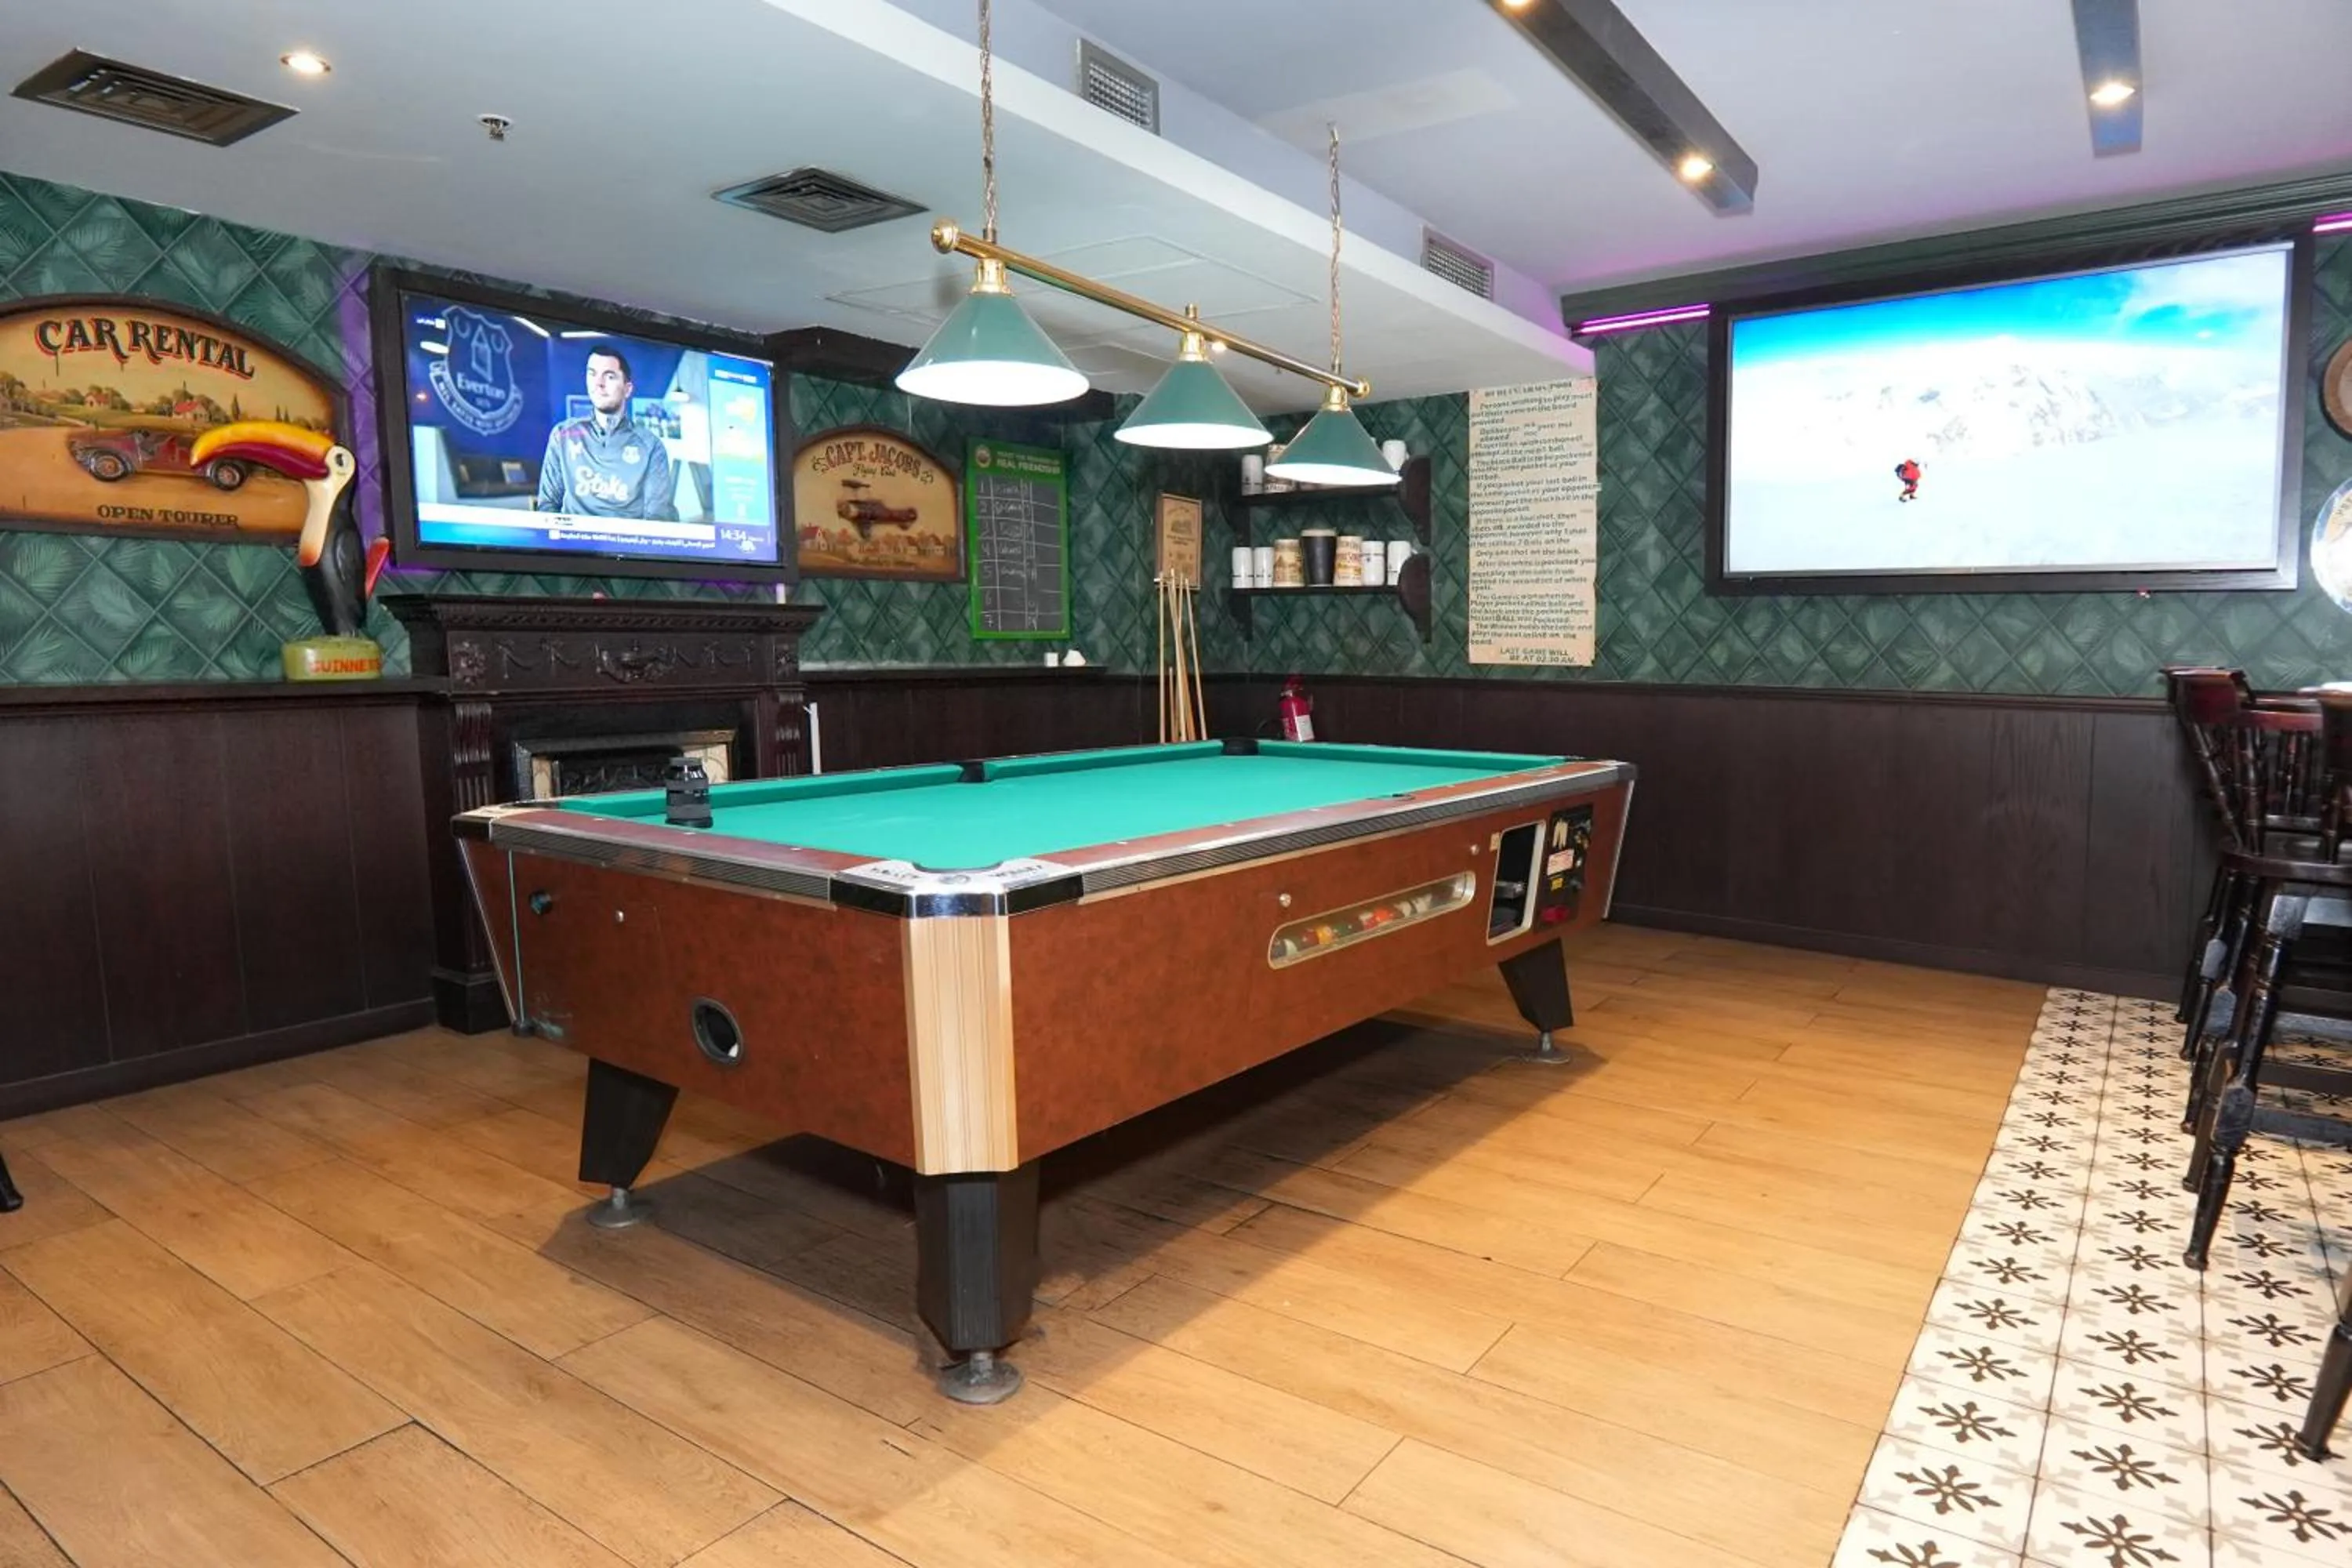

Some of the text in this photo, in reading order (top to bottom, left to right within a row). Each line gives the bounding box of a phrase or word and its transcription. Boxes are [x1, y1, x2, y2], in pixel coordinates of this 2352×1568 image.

[34, 317, 256, 381] CAR RENTAL
[456, 372, 506, 399] Everton
[869, 443, 921, 478] JACOBS
[575, 465, 629, 502] Stake
[97, 504, 239, 528] OPEN TOURER
